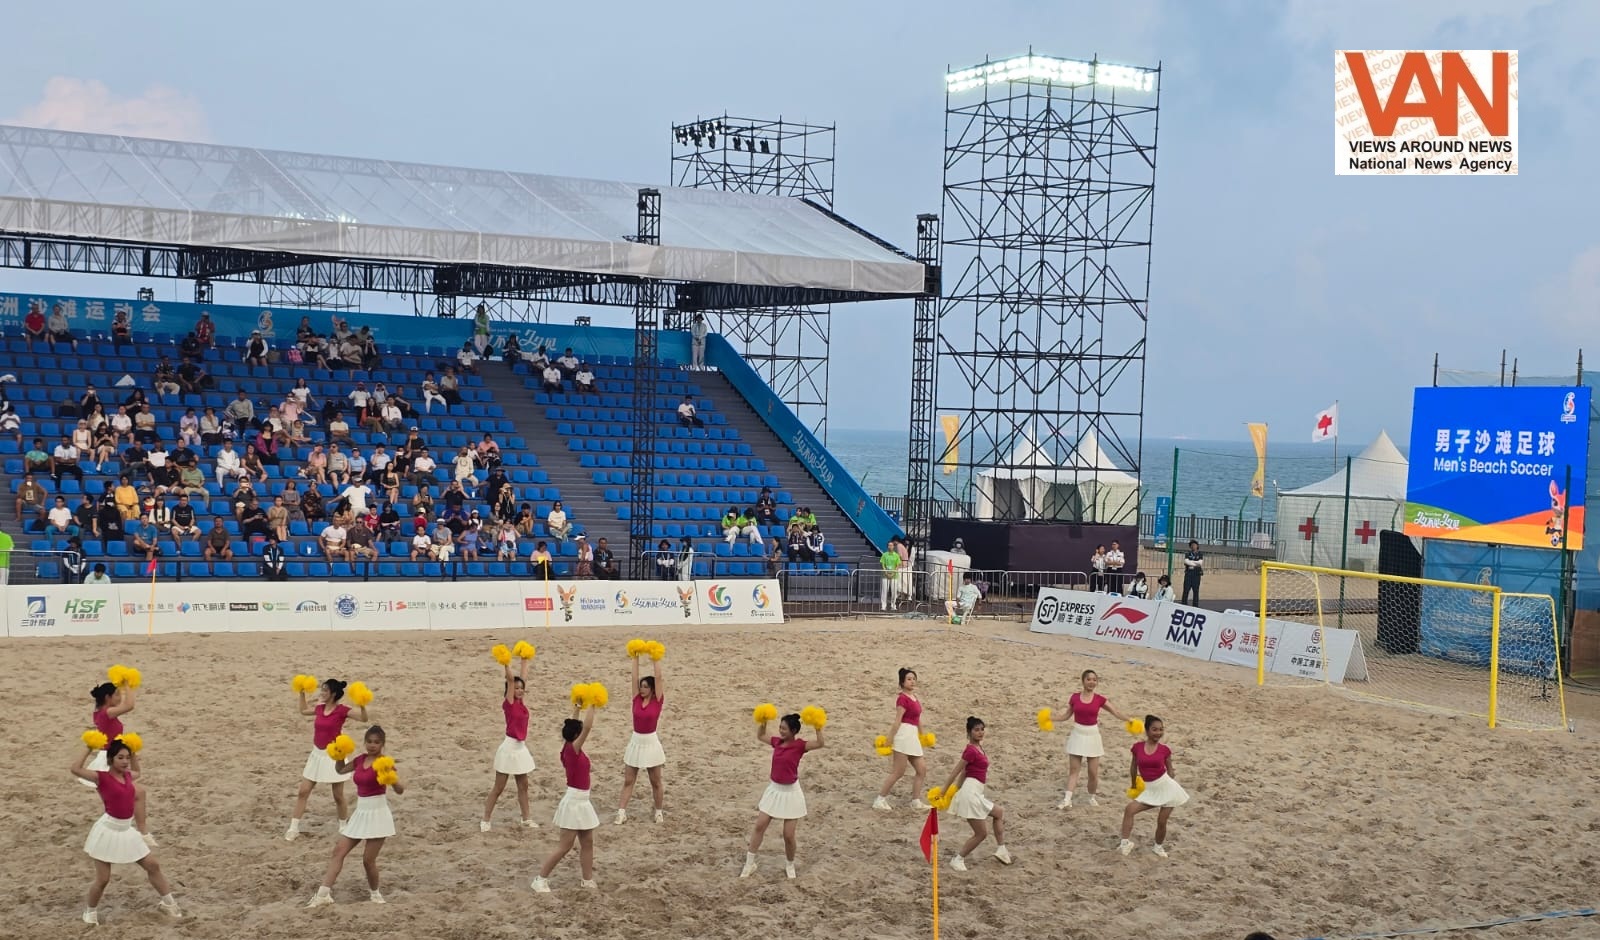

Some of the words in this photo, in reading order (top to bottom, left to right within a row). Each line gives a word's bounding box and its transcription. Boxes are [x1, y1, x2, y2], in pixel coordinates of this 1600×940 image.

[1435, 429, 1556, 457] 男子沙滩足球
[1433, 456, 1468, 473] Men's
[1469, 460, 1508, 475] Beach
[1510, 460, 1554, 477] Soccer
[64, 598, 107, 614] HSF
[1041, 603, 1055, 618] SF
[1059, 601, 1096, 615] EXPRESS
[1170, 608, 1207, 631] BOR
[1096, 625, 1145, 641] LI-NING
[1165, 625, 1203, 648] NAN
